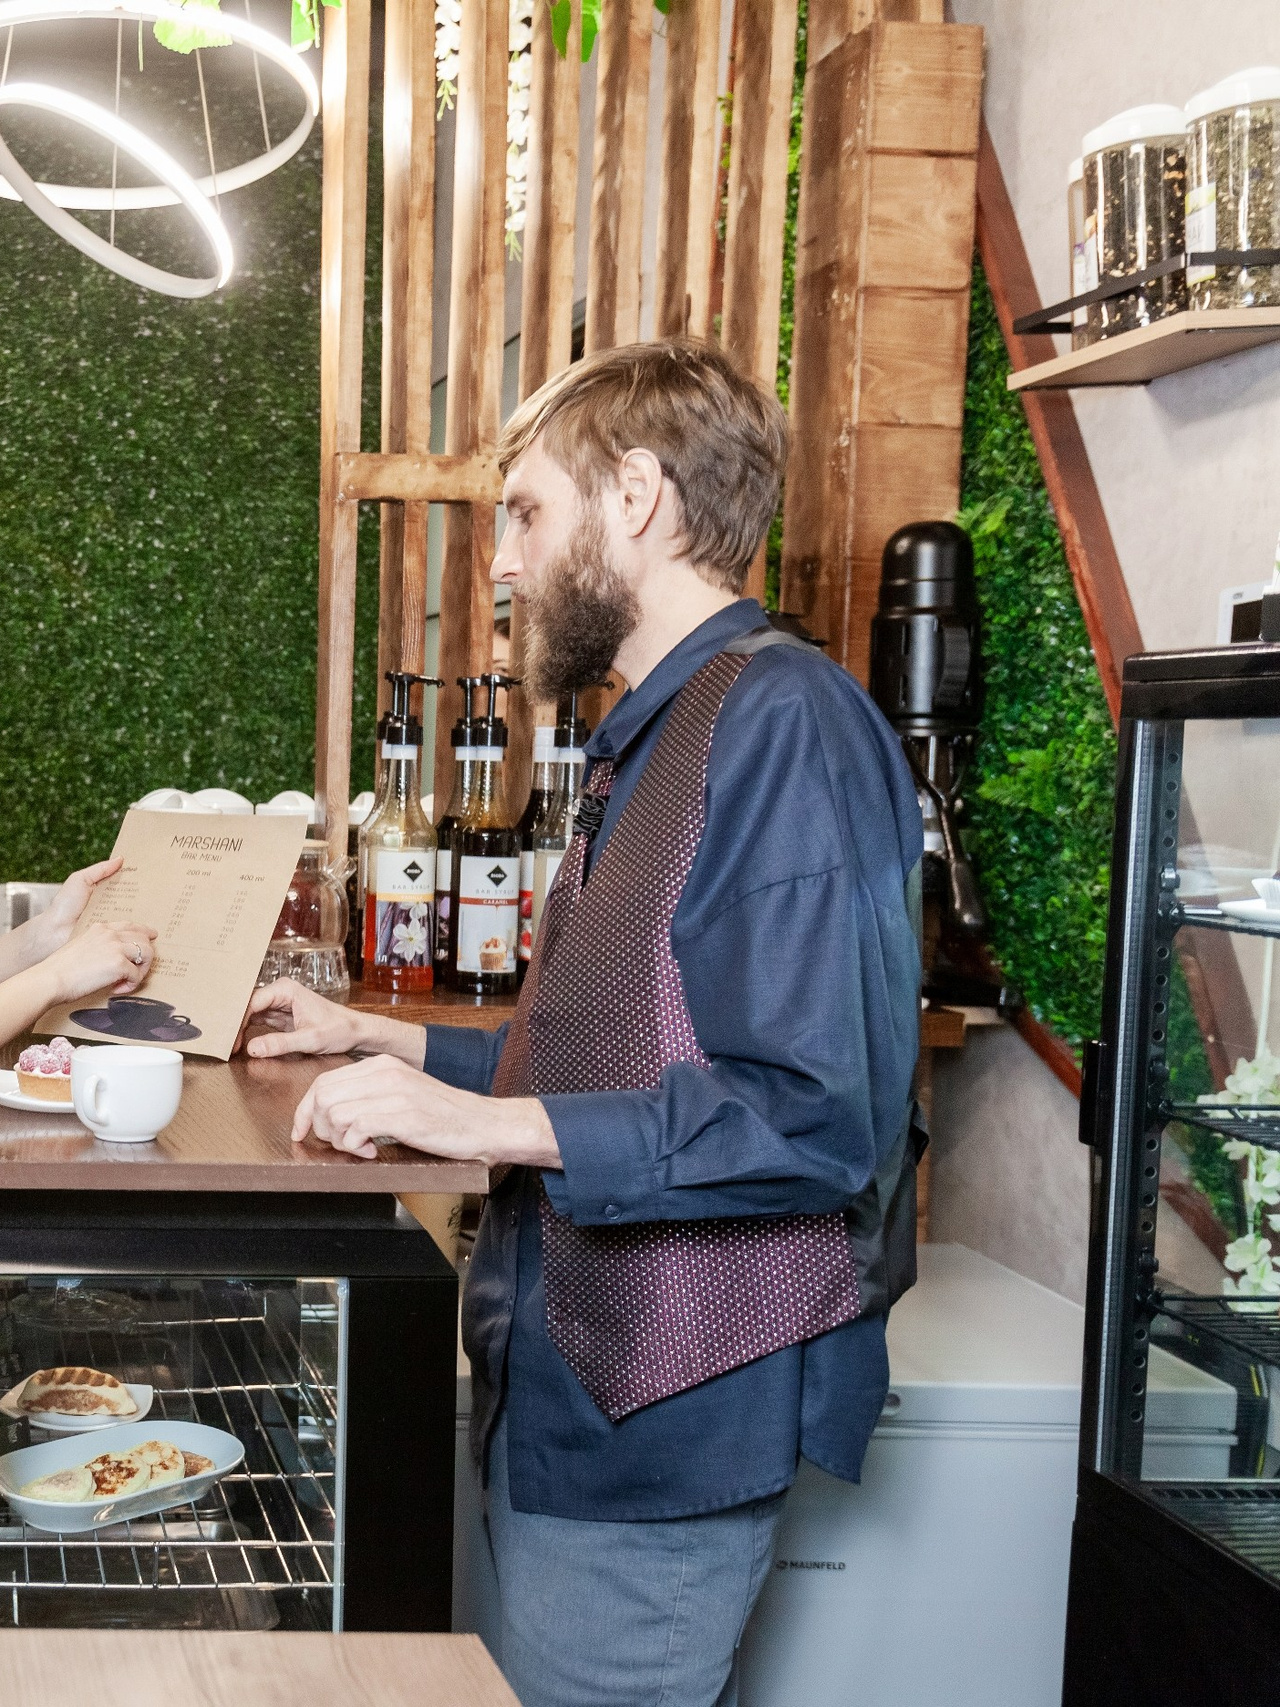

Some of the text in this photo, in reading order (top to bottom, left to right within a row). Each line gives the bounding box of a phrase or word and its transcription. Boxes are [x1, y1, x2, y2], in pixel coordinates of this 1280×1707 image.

[170, 835, 243, 852] MARSHANI
[181, 851, 222, 862] BAR MENU
[789, 1560, 846, 1570] MAUNFELD
